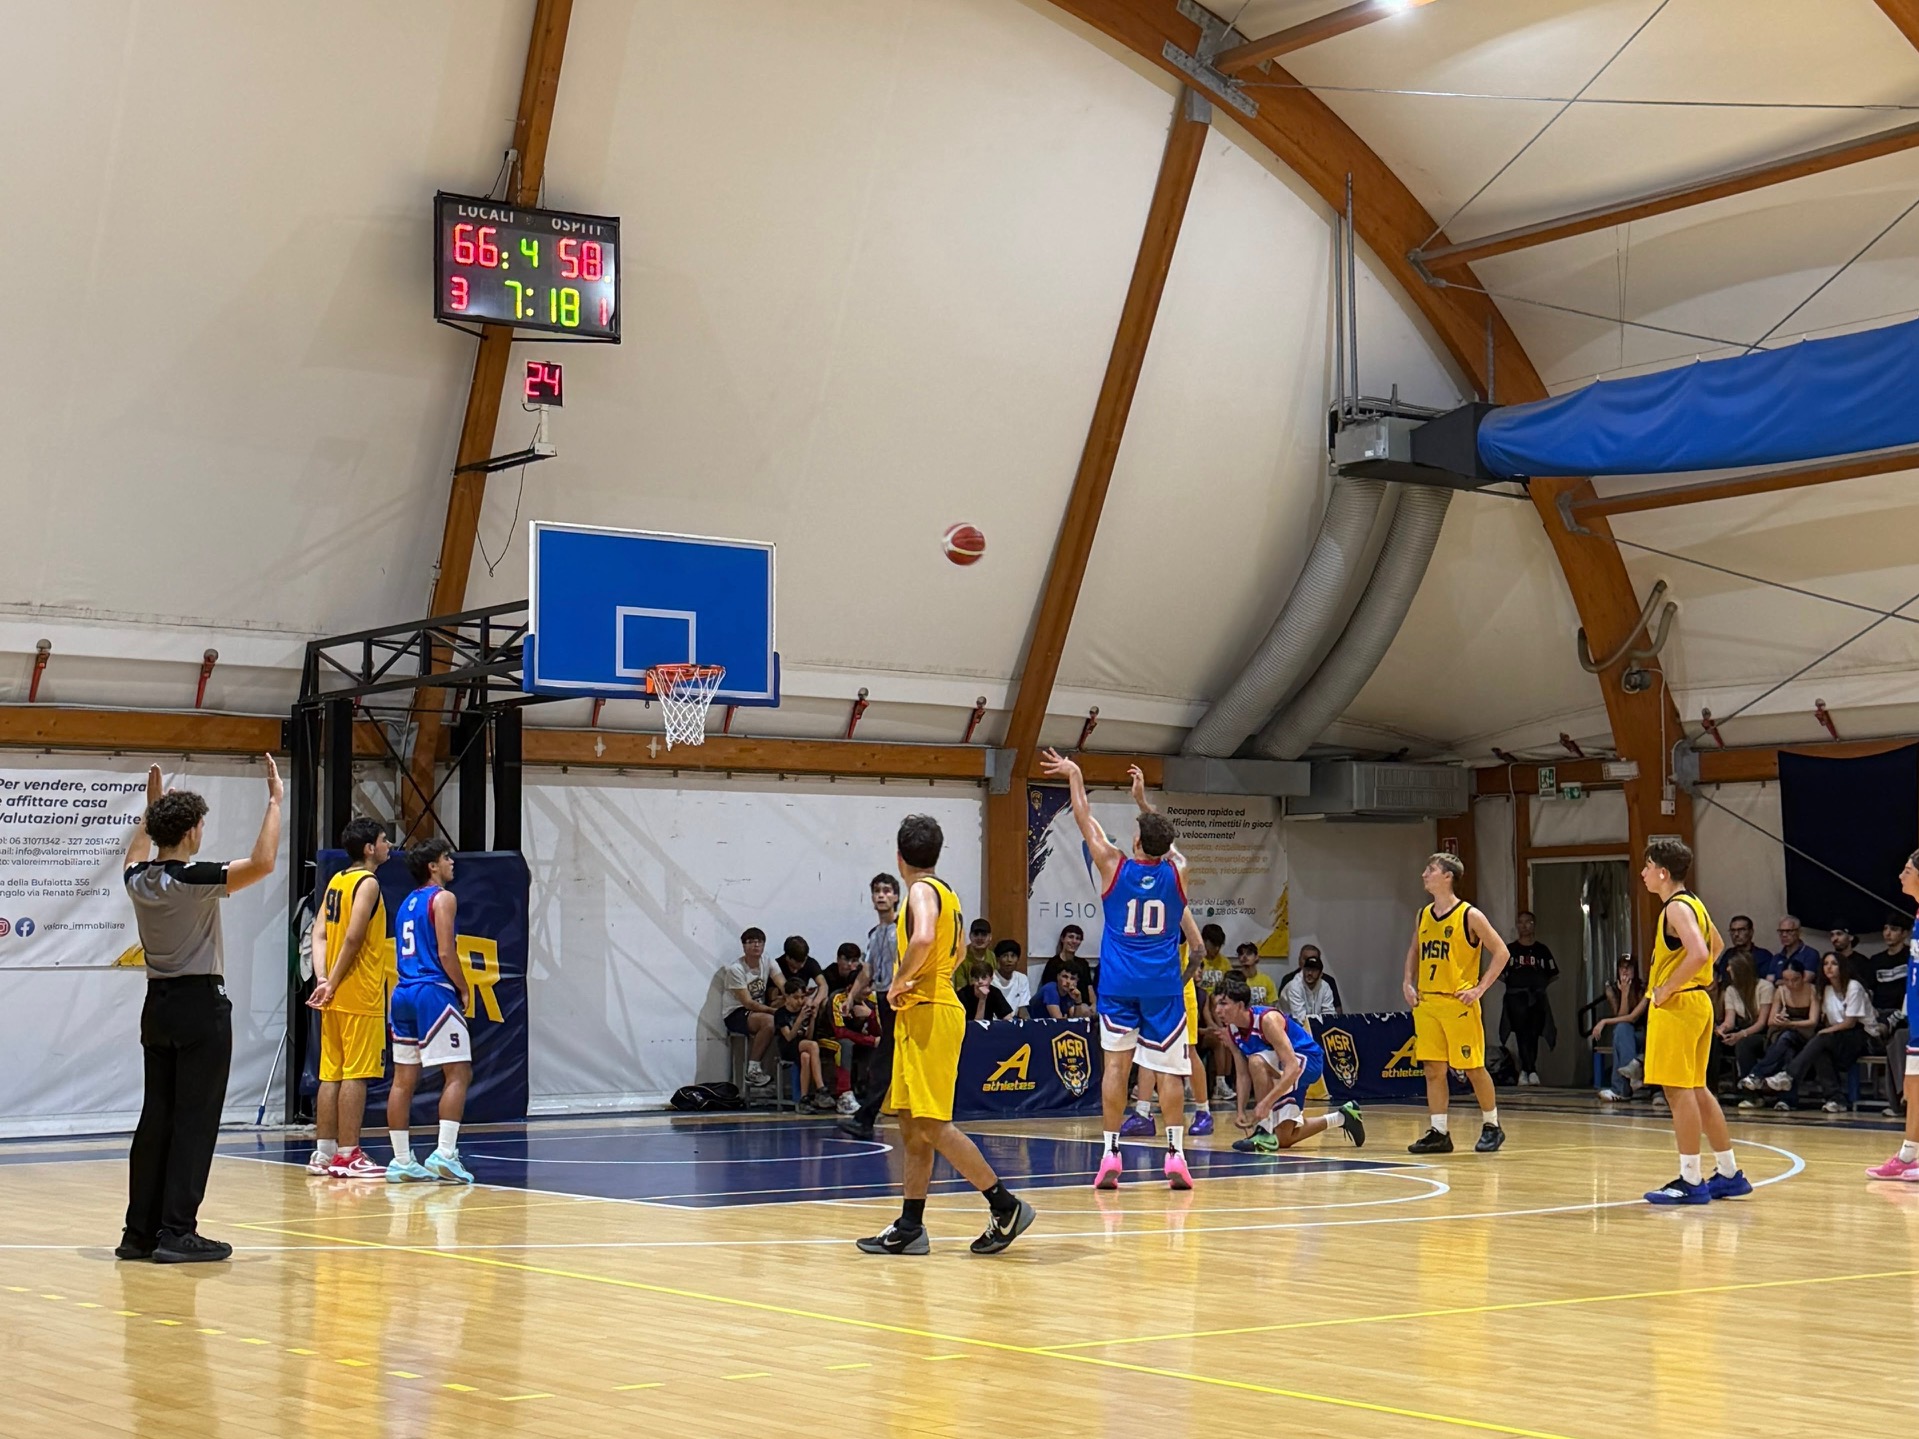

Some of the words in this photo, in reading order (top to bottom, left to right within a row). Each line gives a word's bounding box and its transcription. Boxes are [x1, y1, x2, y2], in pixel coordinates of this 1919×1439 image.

[458, 204, 514, 222] LOCALI
[520, 238, 539, 268] 4
[450, 276, 468, 310] 3
[504, 280, 580, 327] 7:18
[524, 363, 560, 396] 24
[24, 780, 87, 793] vendere,
[6, 795, 69, 808] affittare
[72, 799, 108, 808] casa
[1167, 806, 1206, 817] Recupero
[1207, 808, 1234, 818] rapido
[1235, 808, 1246, 817] ed
[1172, 818, 1208, 829] fficiente,
[9, 837, 21, 845] 06
[8, 879, 29, 887] della
[27, 889, 41, 897] via
[42, 889, 75, 897] Renato
[102, 888, 111, 896] 2)
[1040, 902, 1096, 918] FISIO
[1124, 898, 1166, 936] 10
[402, 920, 416, 956] 5
[1421, 940, 1450, 962] MSR
[1057, 1039, 1084, 1058] MSR
[1326, 1035, 1351, 1052] MSR
[982, 1080, 1036, 1092] athletes
